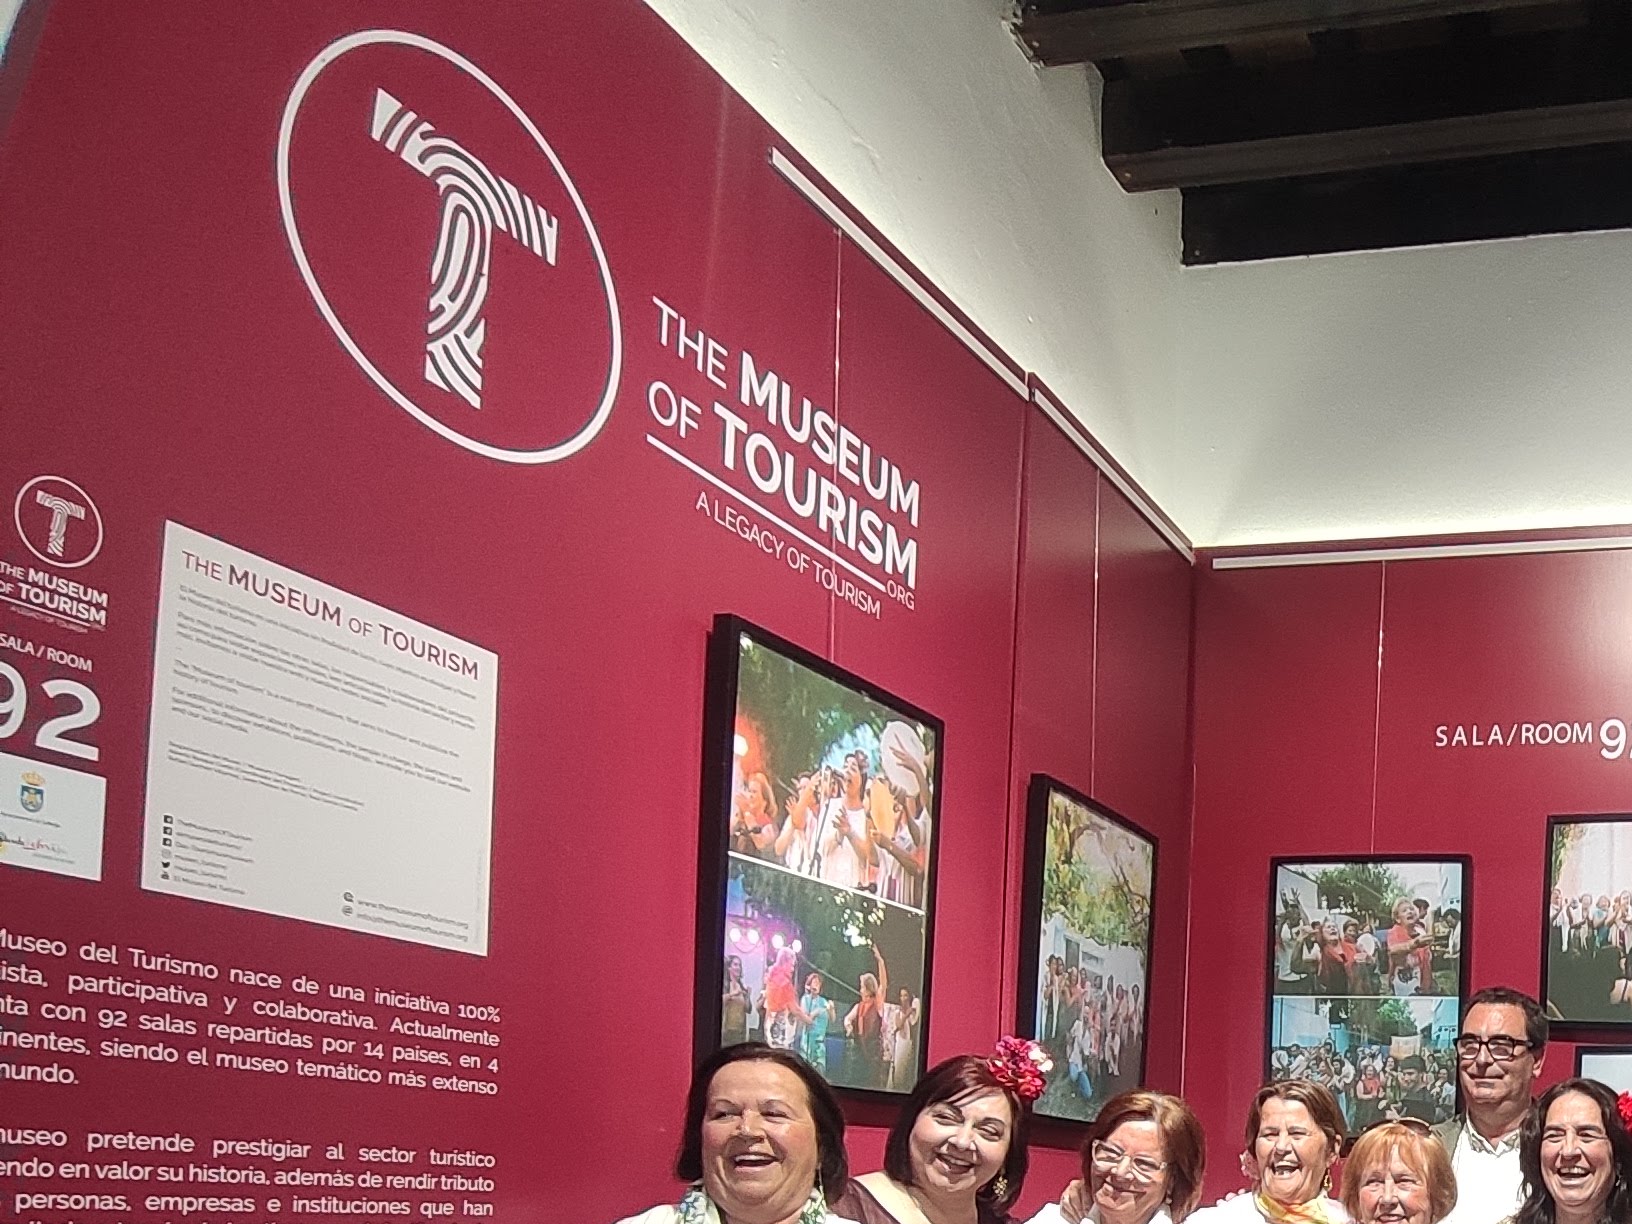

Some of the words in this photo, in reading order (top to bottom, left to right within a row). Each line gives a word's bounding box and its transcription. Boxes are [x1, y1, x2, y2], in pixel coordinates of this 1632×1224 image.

[653, 295, 728, 390] THE
[741, 350, 919, 528] MUSEUM
[648, 381, 702, 438] OF
[714, 401, 917, 589] TOURISM
[18, 583, 107, 625] TOURISM
[28, 567, 108, 608] MUSEUM
[695, 491, 711, 516] A
[714, 500, 784, 559] LEGACY
[787, 547, 810, 573] OF
[813, 560, 881, 619] TOURISM
[47, 647, 93, 673] ROOM
[182, 550, 222, 581] THE
[228, 564, 341, 627] MUSEUM
[348, 617, 373, 637] OF
[379, 623, 478, 681] TOURISM
[80, 942, 118, 964] del
[128, 948, 218, 979] Turismo
[230, 969, 282, 989] nace
[292, 975, 319, 994] de
[329, 985, 365, 1002] una
[375, 988, 449, 1015] iniciativa
[458, 1004, 500, 1022] 100%
